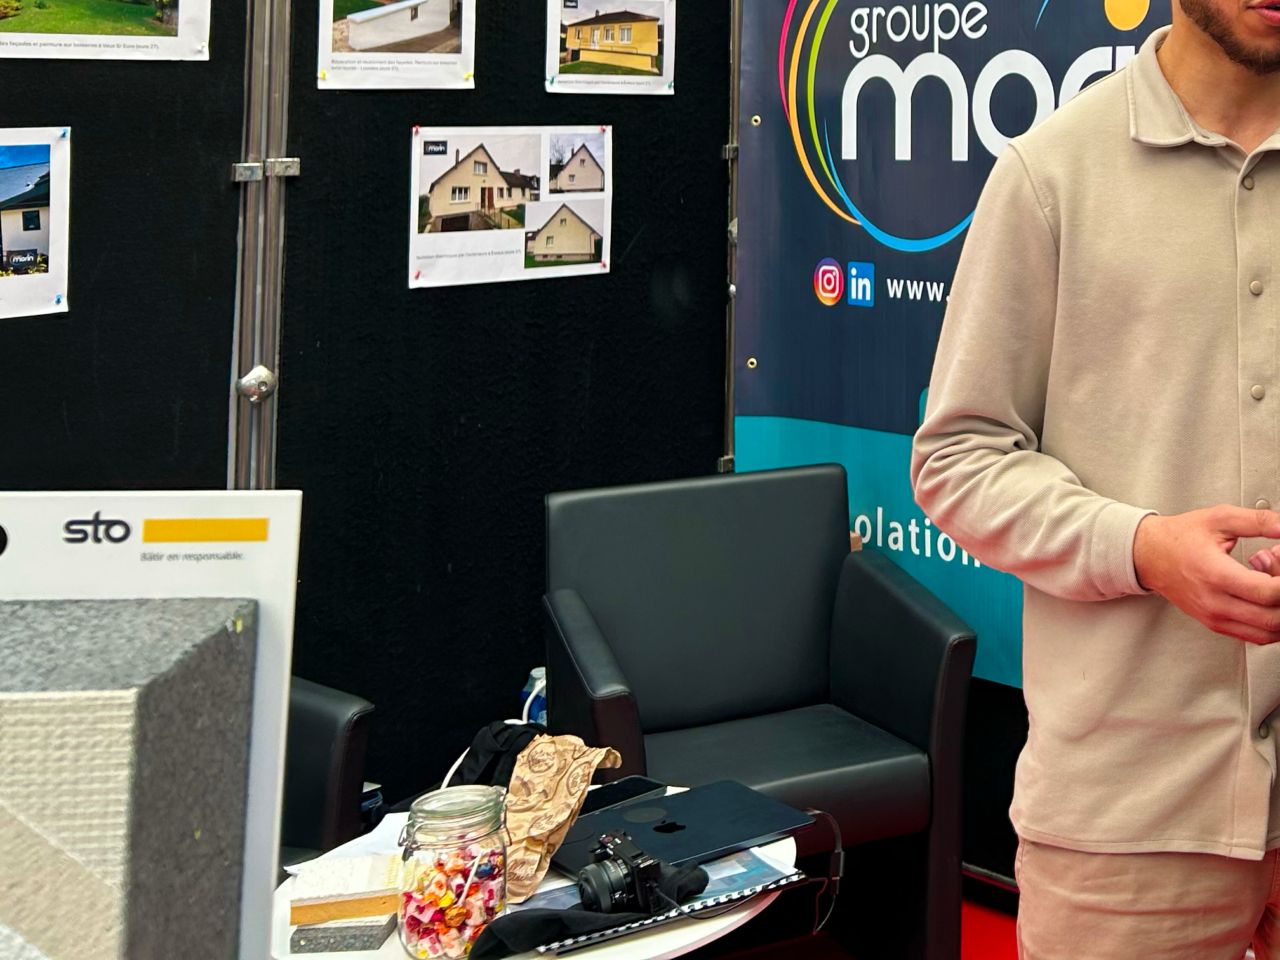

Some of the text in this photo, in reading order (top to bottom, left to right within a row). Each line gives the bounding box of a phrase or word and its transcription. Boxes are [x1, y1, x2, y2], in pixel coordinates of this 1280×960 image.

[849, 1, 989, 59] groupe
[62, 510, 132, 544] sto
[166, 554, 179, 562] en
